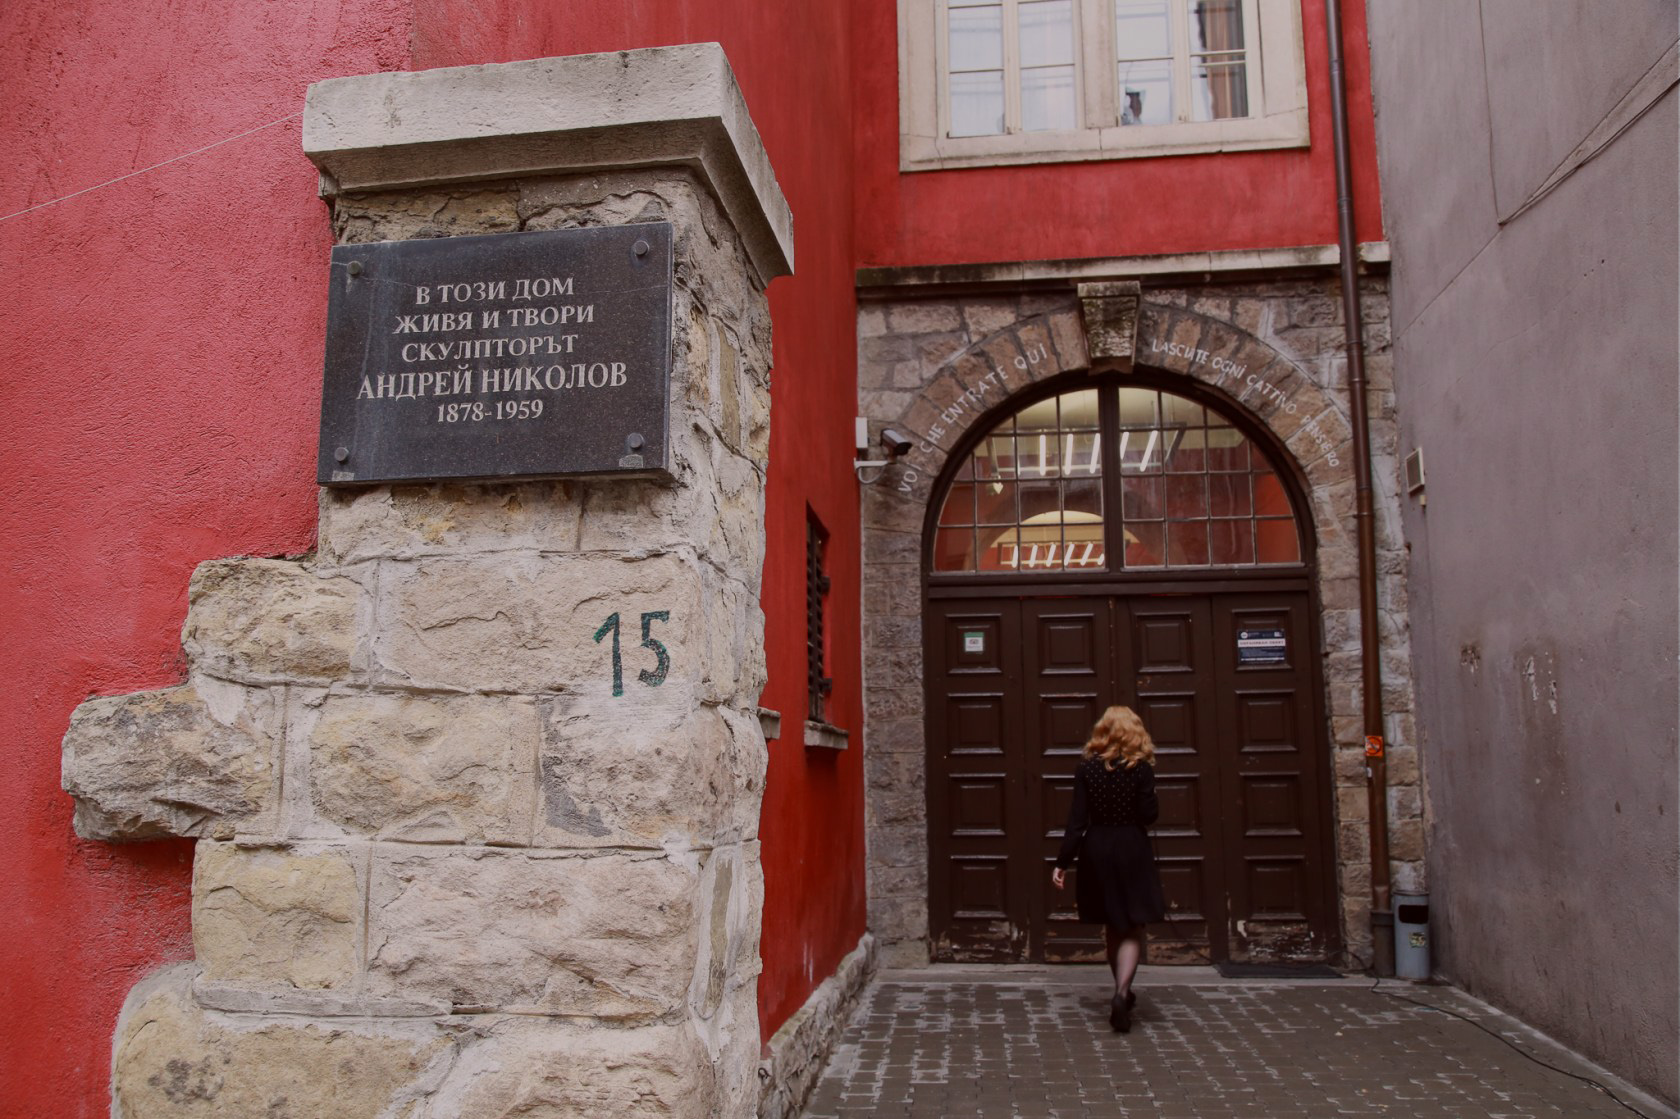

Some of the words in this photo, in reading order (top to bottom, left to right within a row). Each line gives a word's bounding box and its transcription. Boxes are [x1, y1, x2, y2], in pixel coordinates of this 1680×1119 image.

[415, 287, 430, 305] В
[437, 279, 506, 303] ТОЗИ
[512, 276, 574, 301] ДОМ
[393, 311, 473, 334] ЖИВЯ
[482, 310, 499, 329] И
[507, 304, 594, 327] ТВОРИ
[401, 334, 578, 363] СКУЛПТОРЪТ
[356, 365, 473, 401] АНДРЕЙ
[481, 362, 627, 393] НИКОЛОВ
[437, 399, 544, 423] 1878-1959
[920, 423, 946, 454] CHE
[940, 365, 1009, 424] ENTRATE
[592, 610, 670, 697] 15
